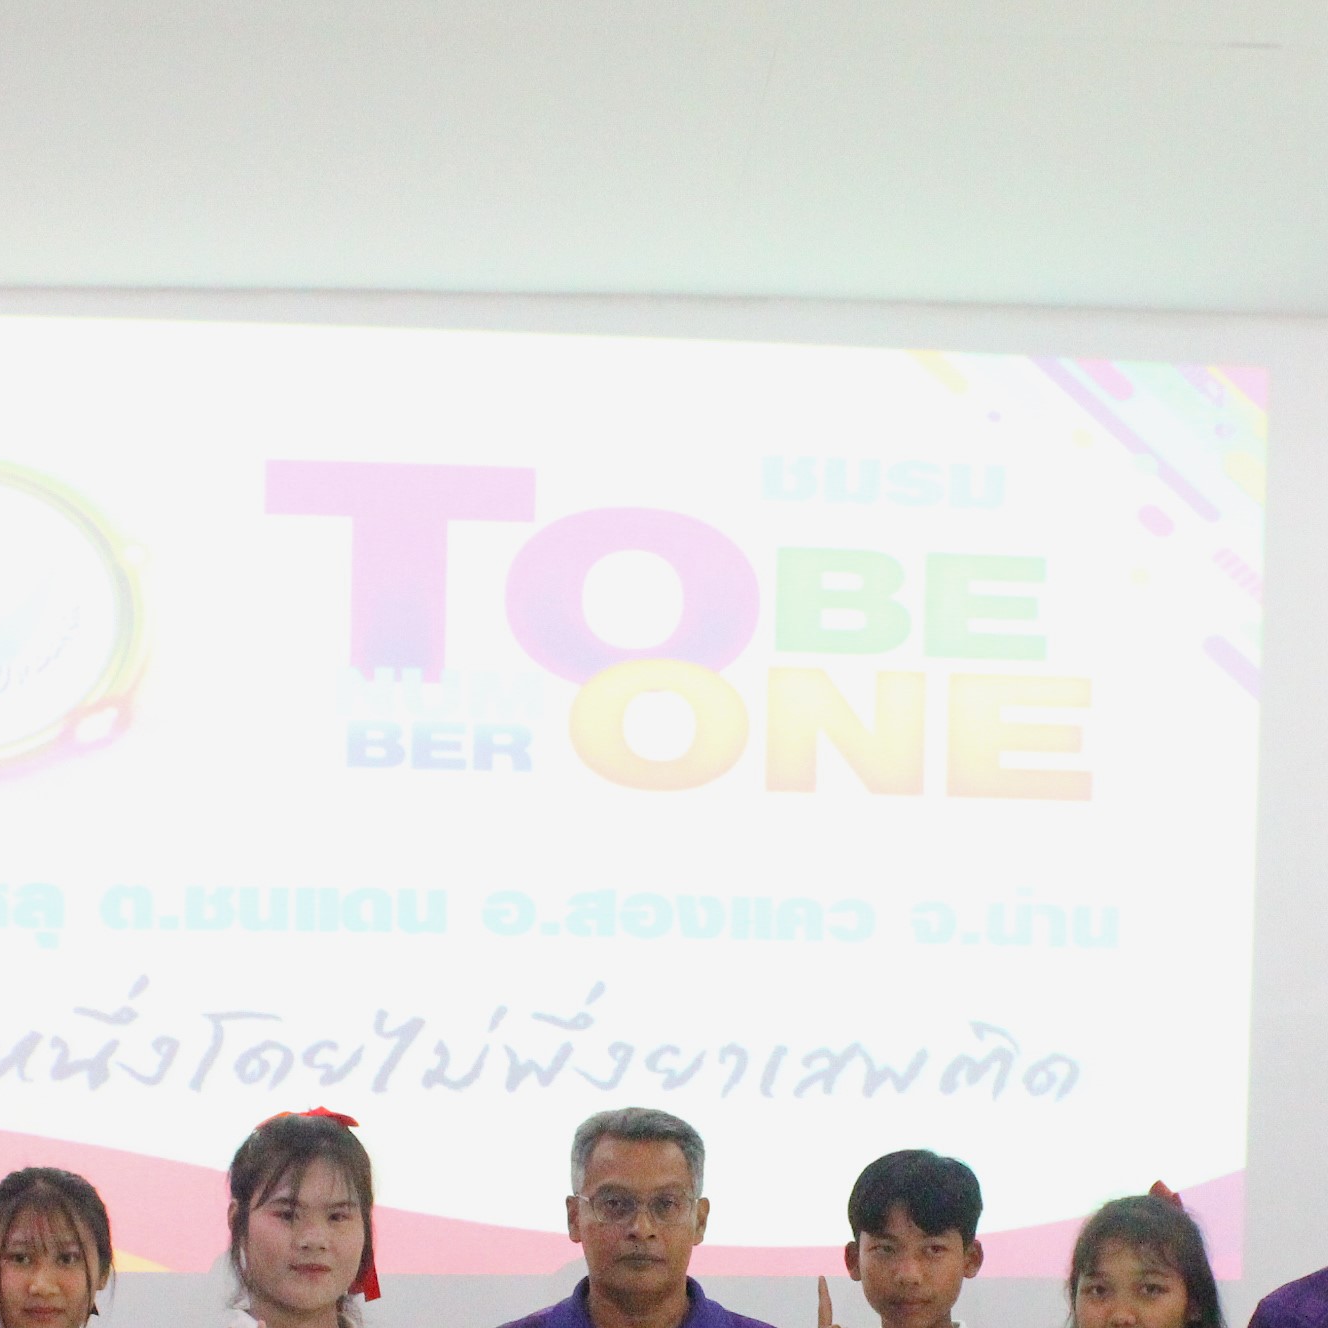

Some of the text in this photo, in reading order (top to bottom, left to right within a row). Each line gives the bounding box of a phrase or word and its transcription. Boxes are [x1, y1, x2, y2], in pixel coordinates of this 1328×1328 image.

[265, 459, 760, 689] TO
[775, 545, 1048, 661] BE
[346, 719, 534, 774] BER
[568, 658, 1093, 802] ONE
